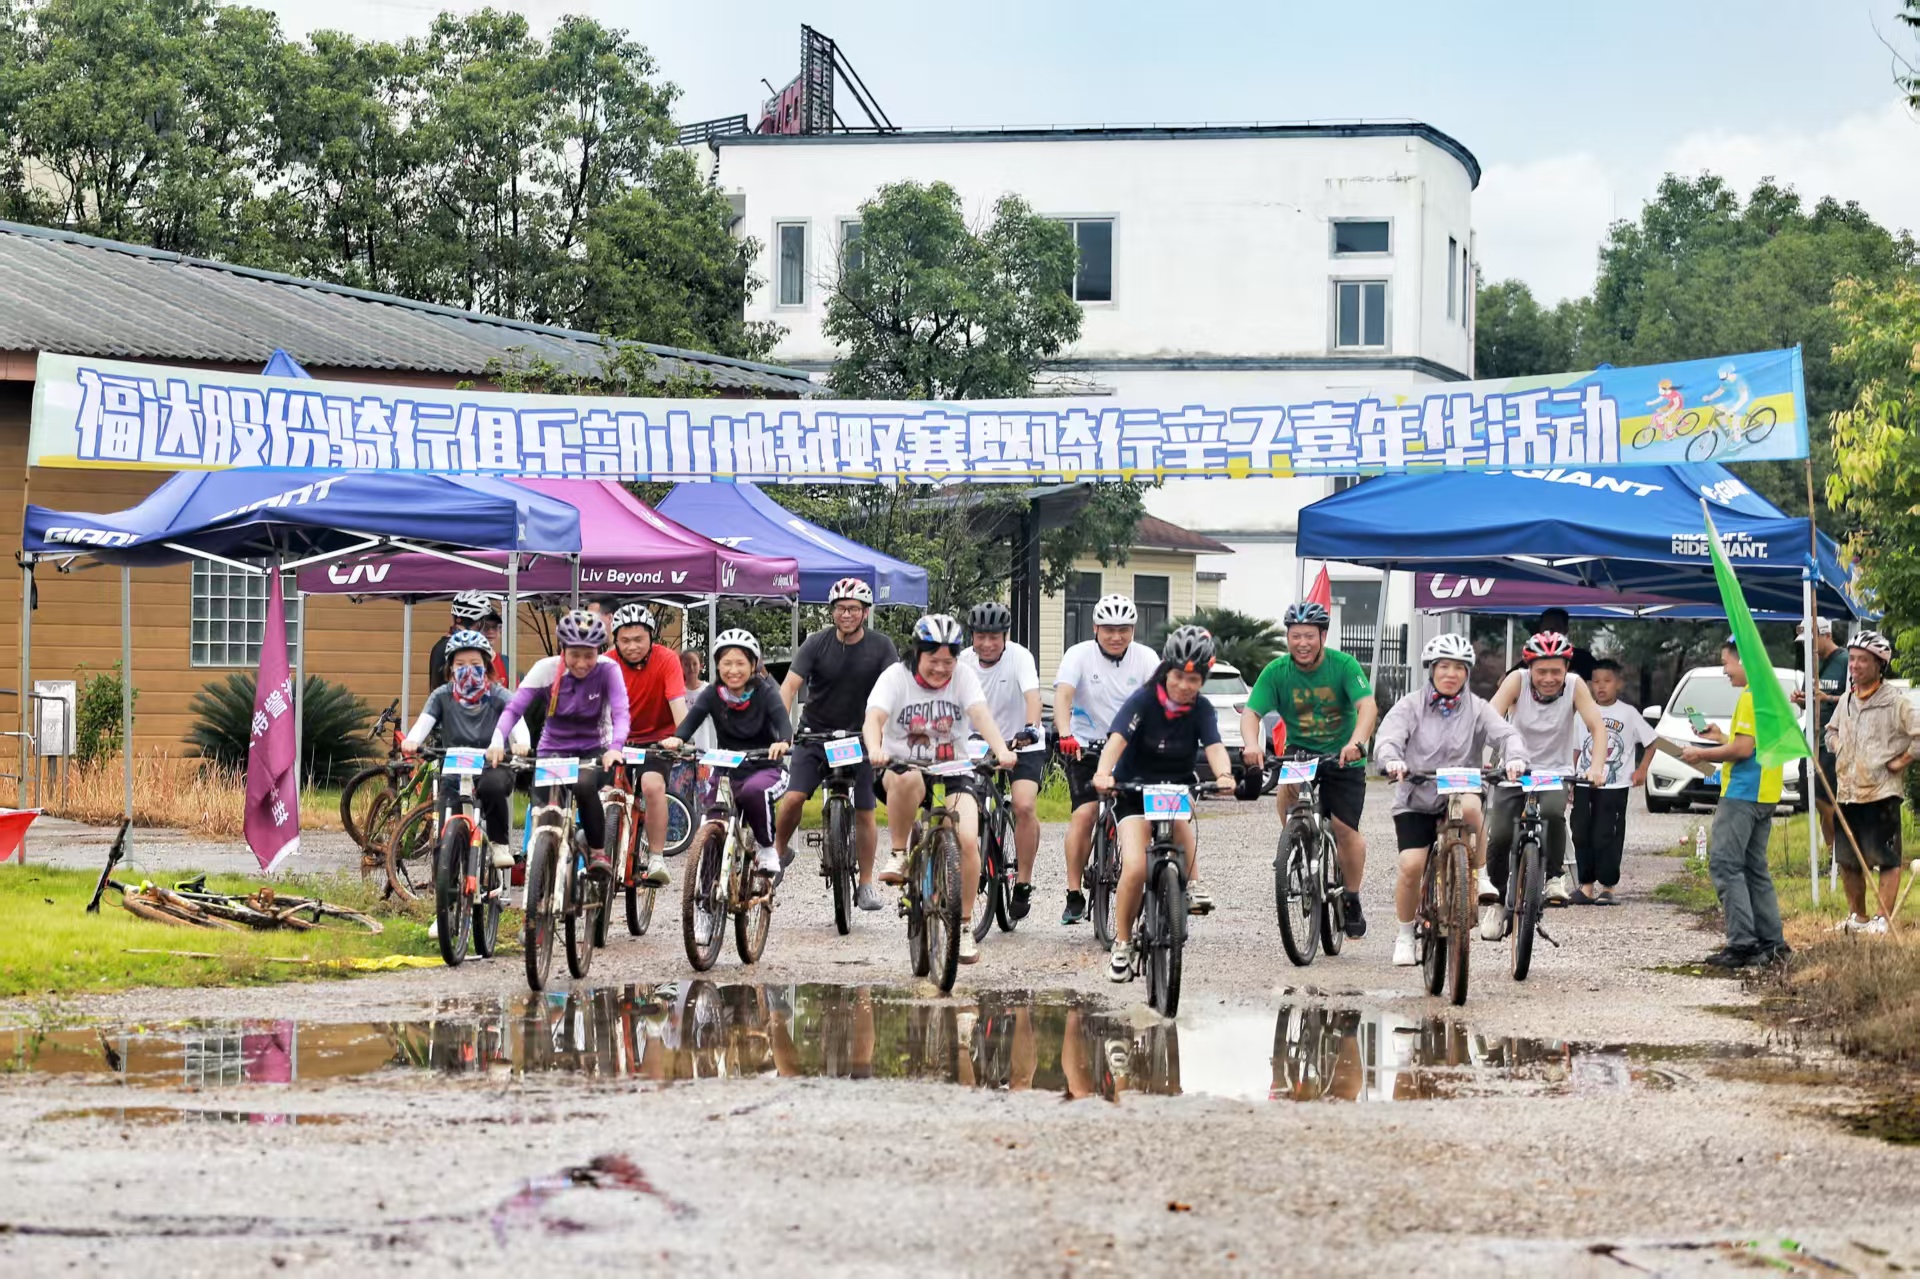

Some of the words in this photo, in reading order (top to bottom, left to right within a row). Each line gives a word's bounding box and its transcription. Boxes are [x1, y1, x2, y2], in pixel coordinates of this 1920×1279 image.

[209, 475, 349, 522] ANT
[1714, 542, 1768, 558] IANT.
[581, 568, 603, 582] Liv
[606, 569, 665, 585] Beyond.
[897, 700, 962, 725] ABSOLUTE
